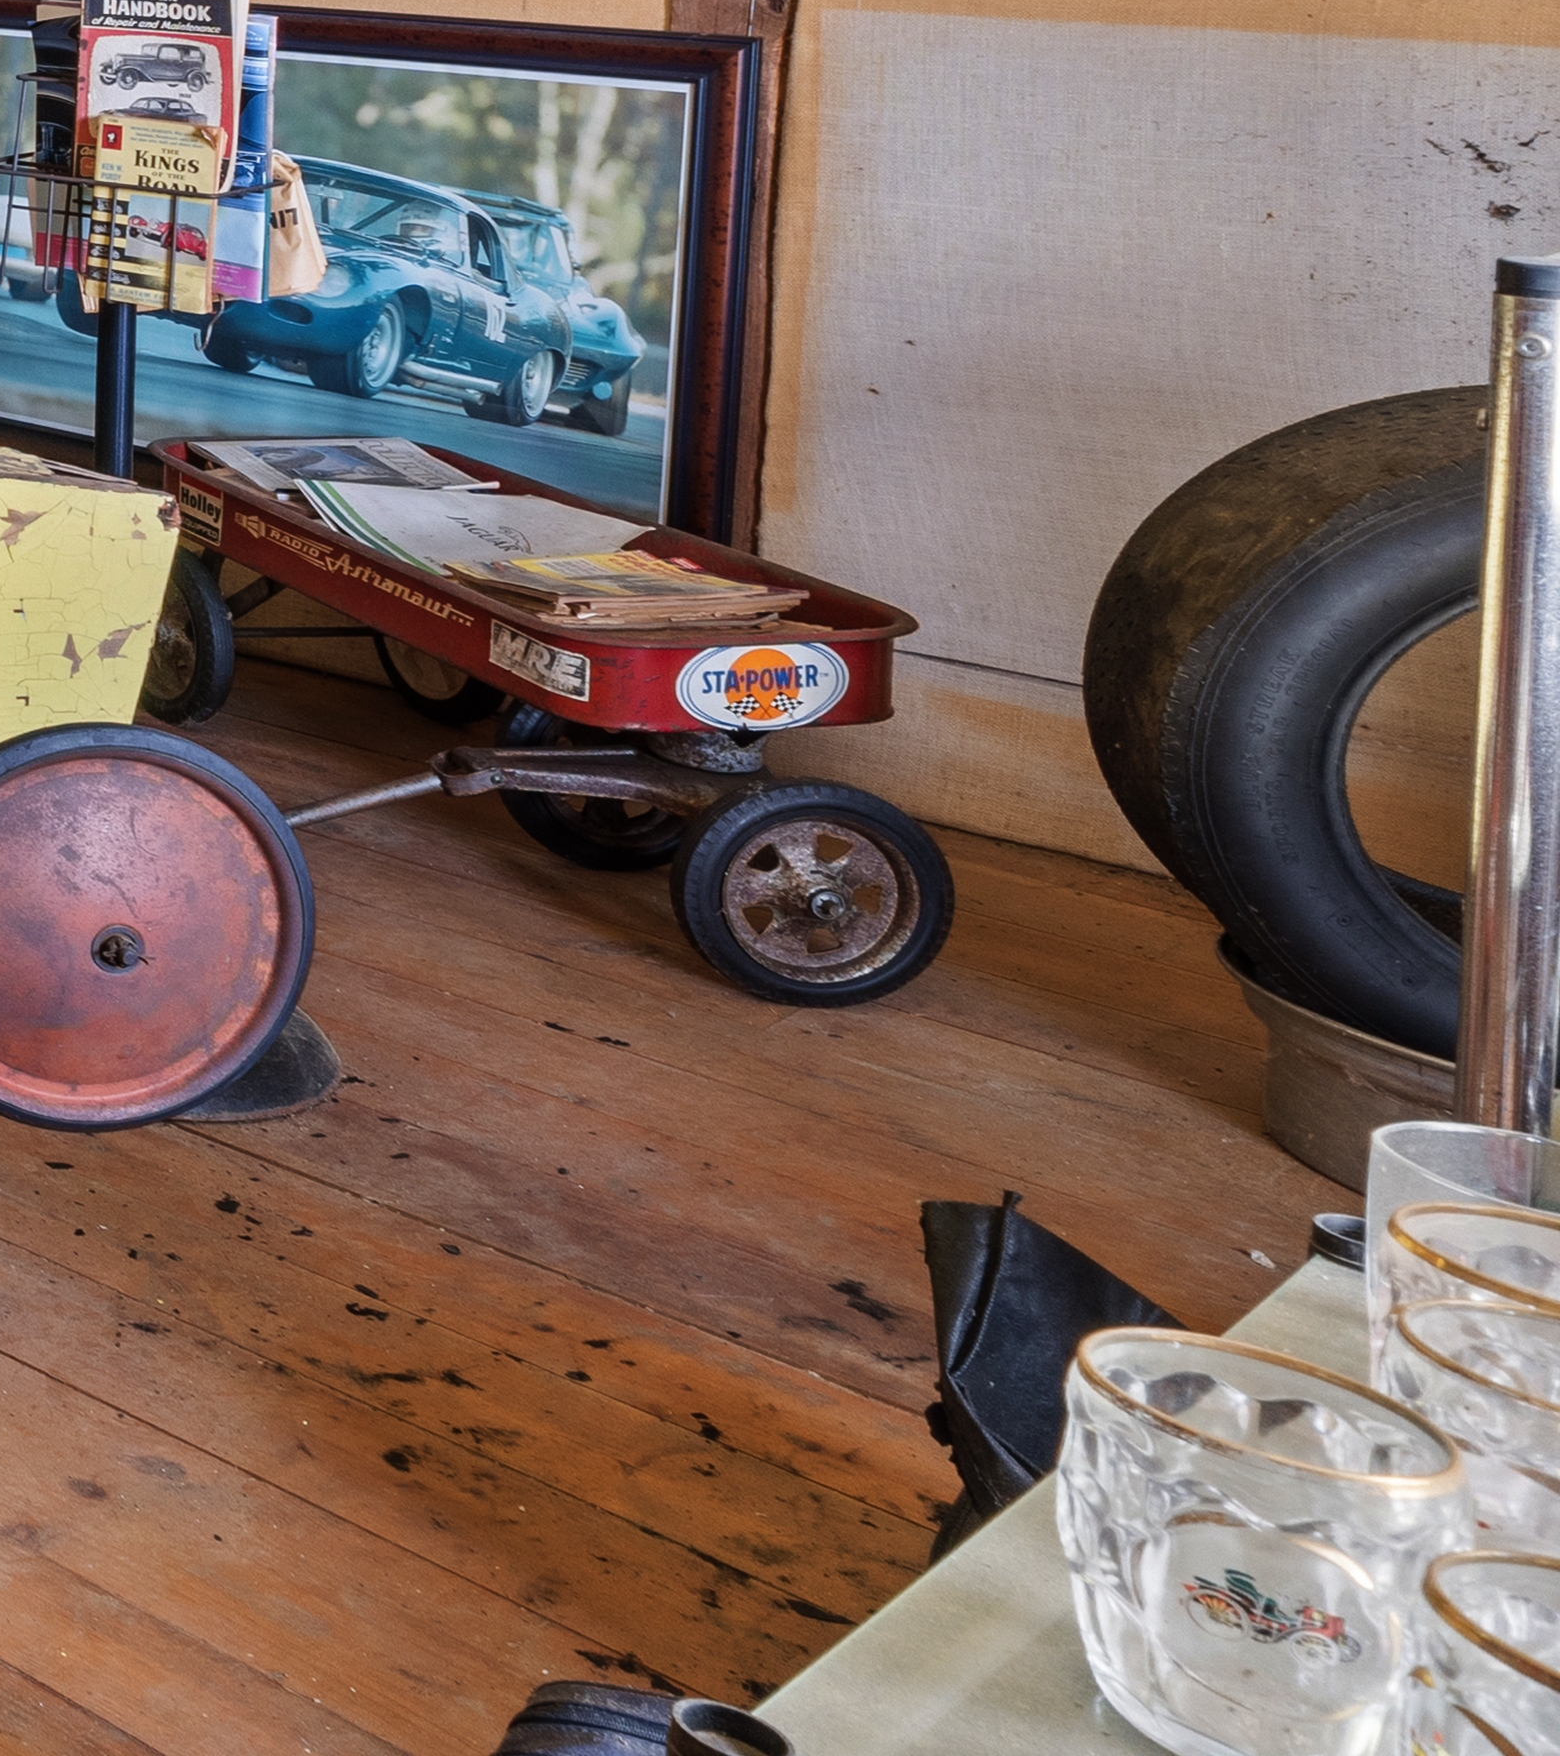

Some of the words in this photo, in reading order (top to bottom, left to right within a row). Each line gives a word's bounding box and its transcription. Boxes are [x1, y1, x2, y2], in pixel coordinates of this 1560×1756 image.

[91, 16, 104, 26] of
[103, 17, 138, 29] Repair
[138, 19, 158, 29] and
[160, 20, 222, 34] Maintenance
[134, 149, 200, 174] KINGS
[160, 147, 180, 156] THE
[151, 170, 166, 178] OF
[167, 172, 186, 181] THE
[180, 486, 222, 524] Holley
[270, 527, 321, 559] RADIO
[445, 514, 520, 553] JAGUAR
